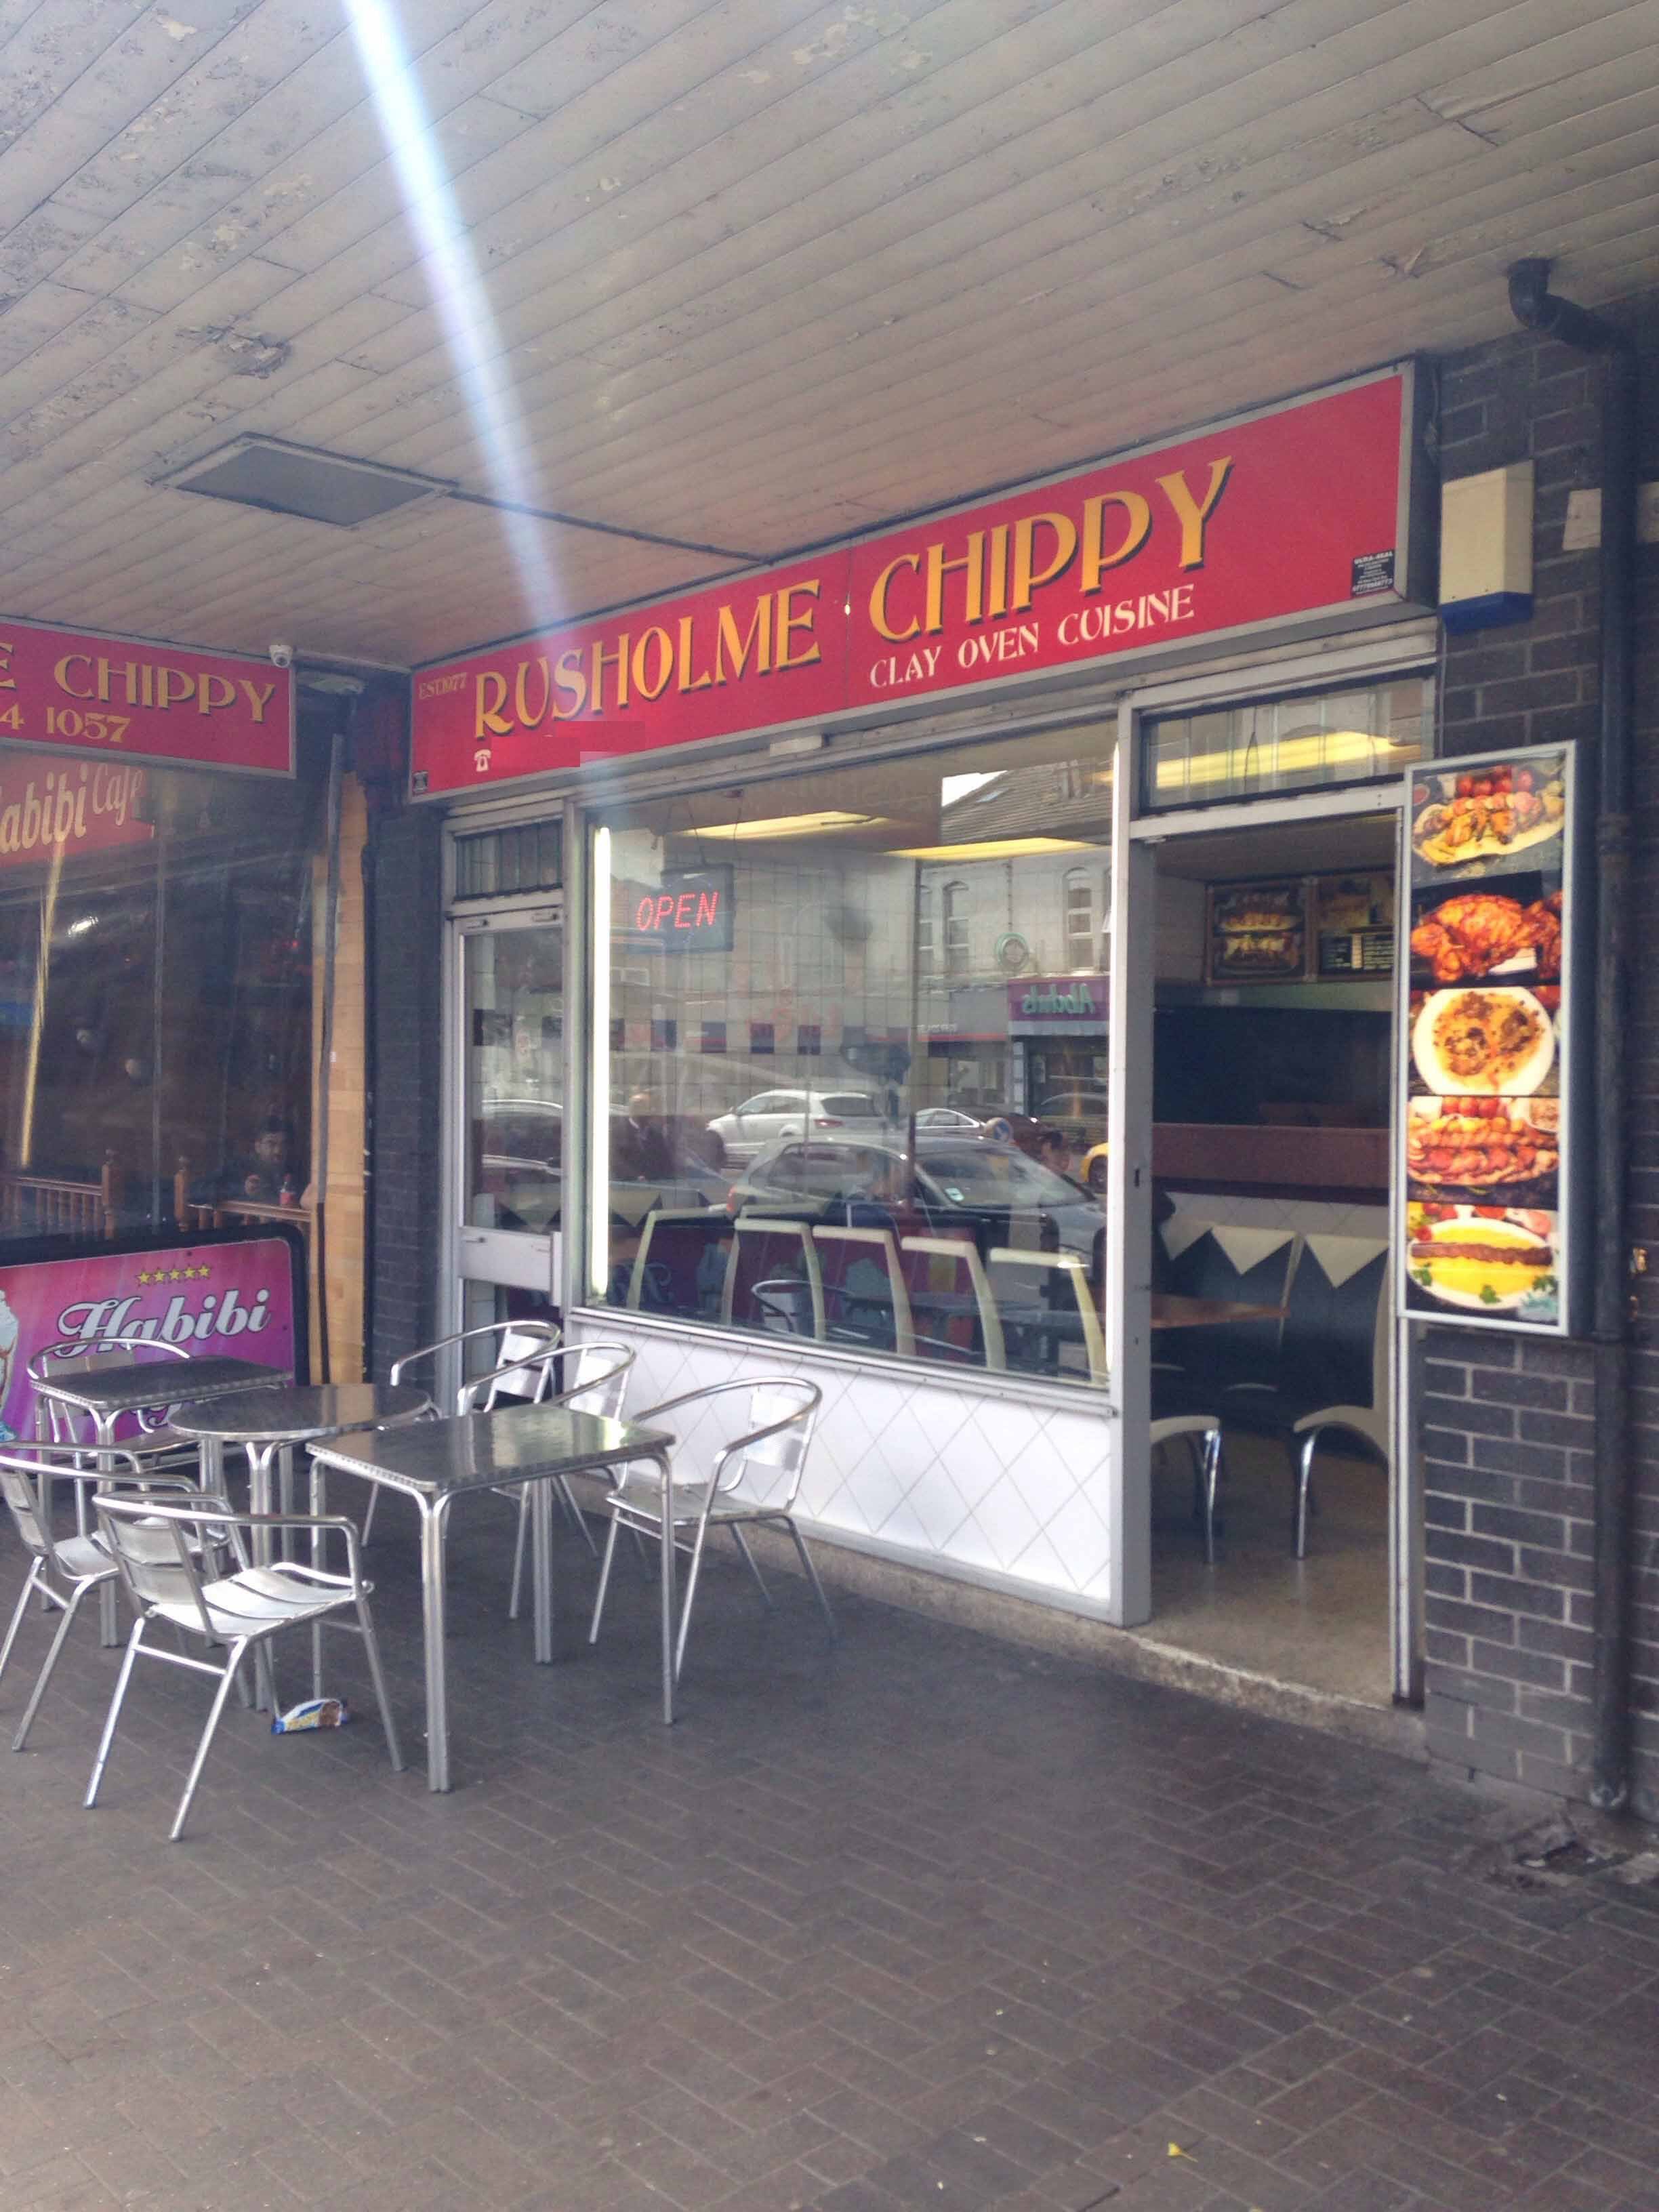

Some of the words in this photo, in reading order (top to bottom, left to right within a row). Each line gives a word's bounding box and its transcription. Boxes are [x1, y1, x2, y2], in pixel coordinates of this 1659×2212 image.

[475, 579, 821, 739] RUSHOLME
[869, 455, 1233, 642] CHIPPY
[870, 646, 941, 687] CLAY
[956, 621, 1038, 669] OVEN
[1057, 583, 1195, 646] CUISINE
[54, 654, 276, 723] CHIPPY
[47, 707, 131, 743] 1057
[0, 762, 87, 854] abibi
[634, 891, 719, 932] OPEN
[54, 1288, 270, 1358] Habibi
